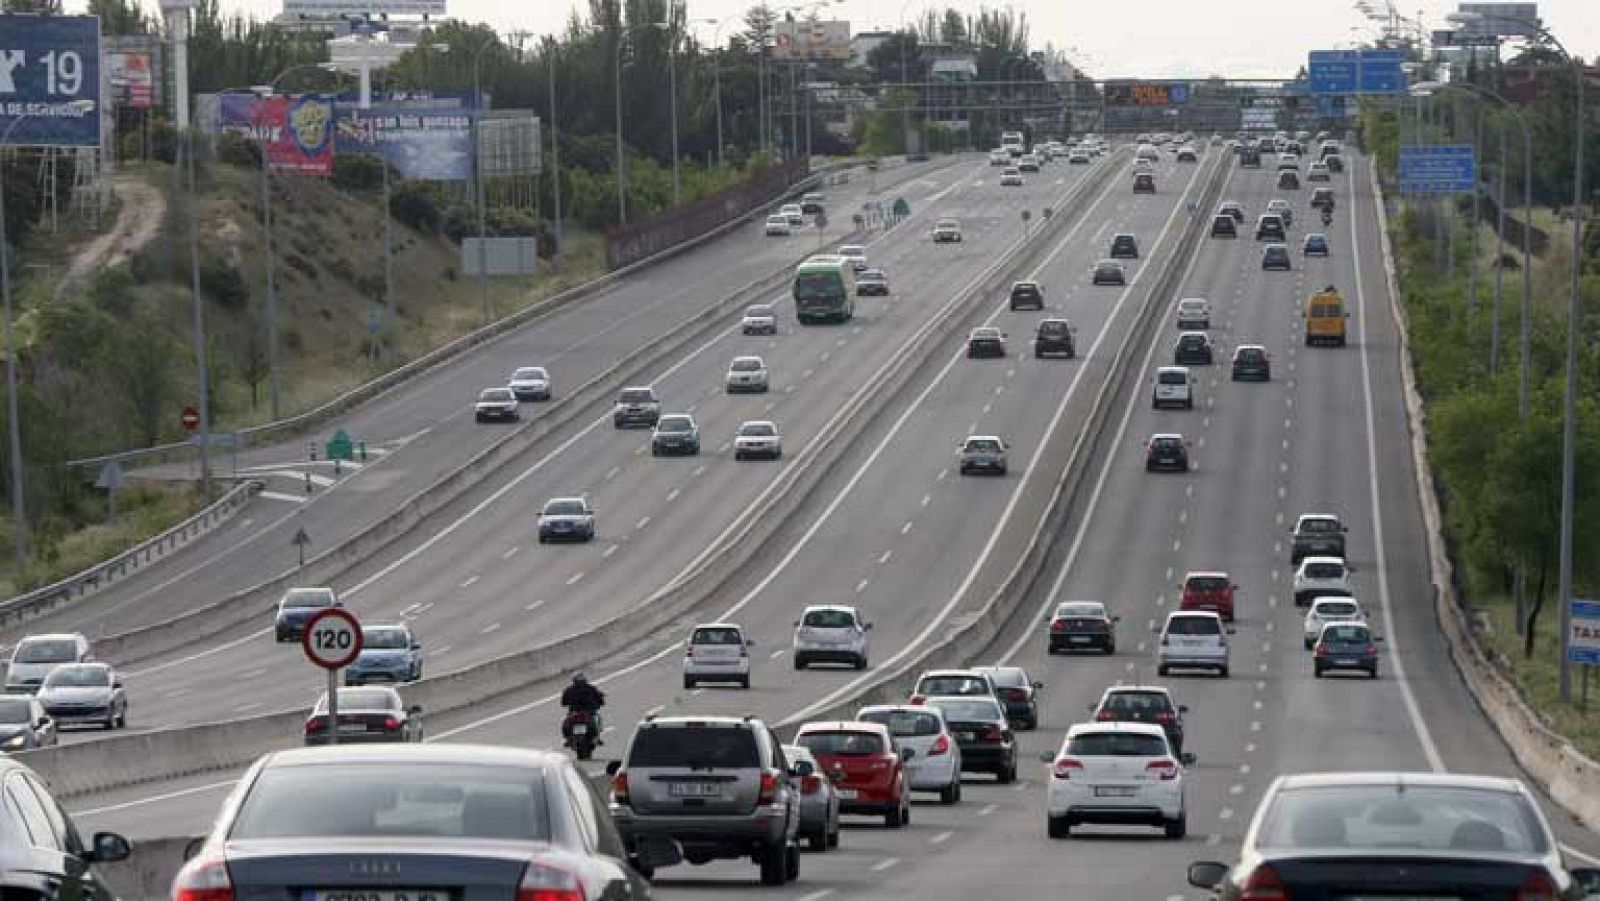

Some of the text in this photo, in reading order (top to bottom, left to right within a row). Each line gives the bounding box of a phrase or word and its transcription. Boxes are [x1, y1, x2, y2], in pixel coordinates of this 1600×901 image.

[38, 50, 82, 95] 19
[7, 103, 22, 116] DE
[314, 629, 351, 649] 120
